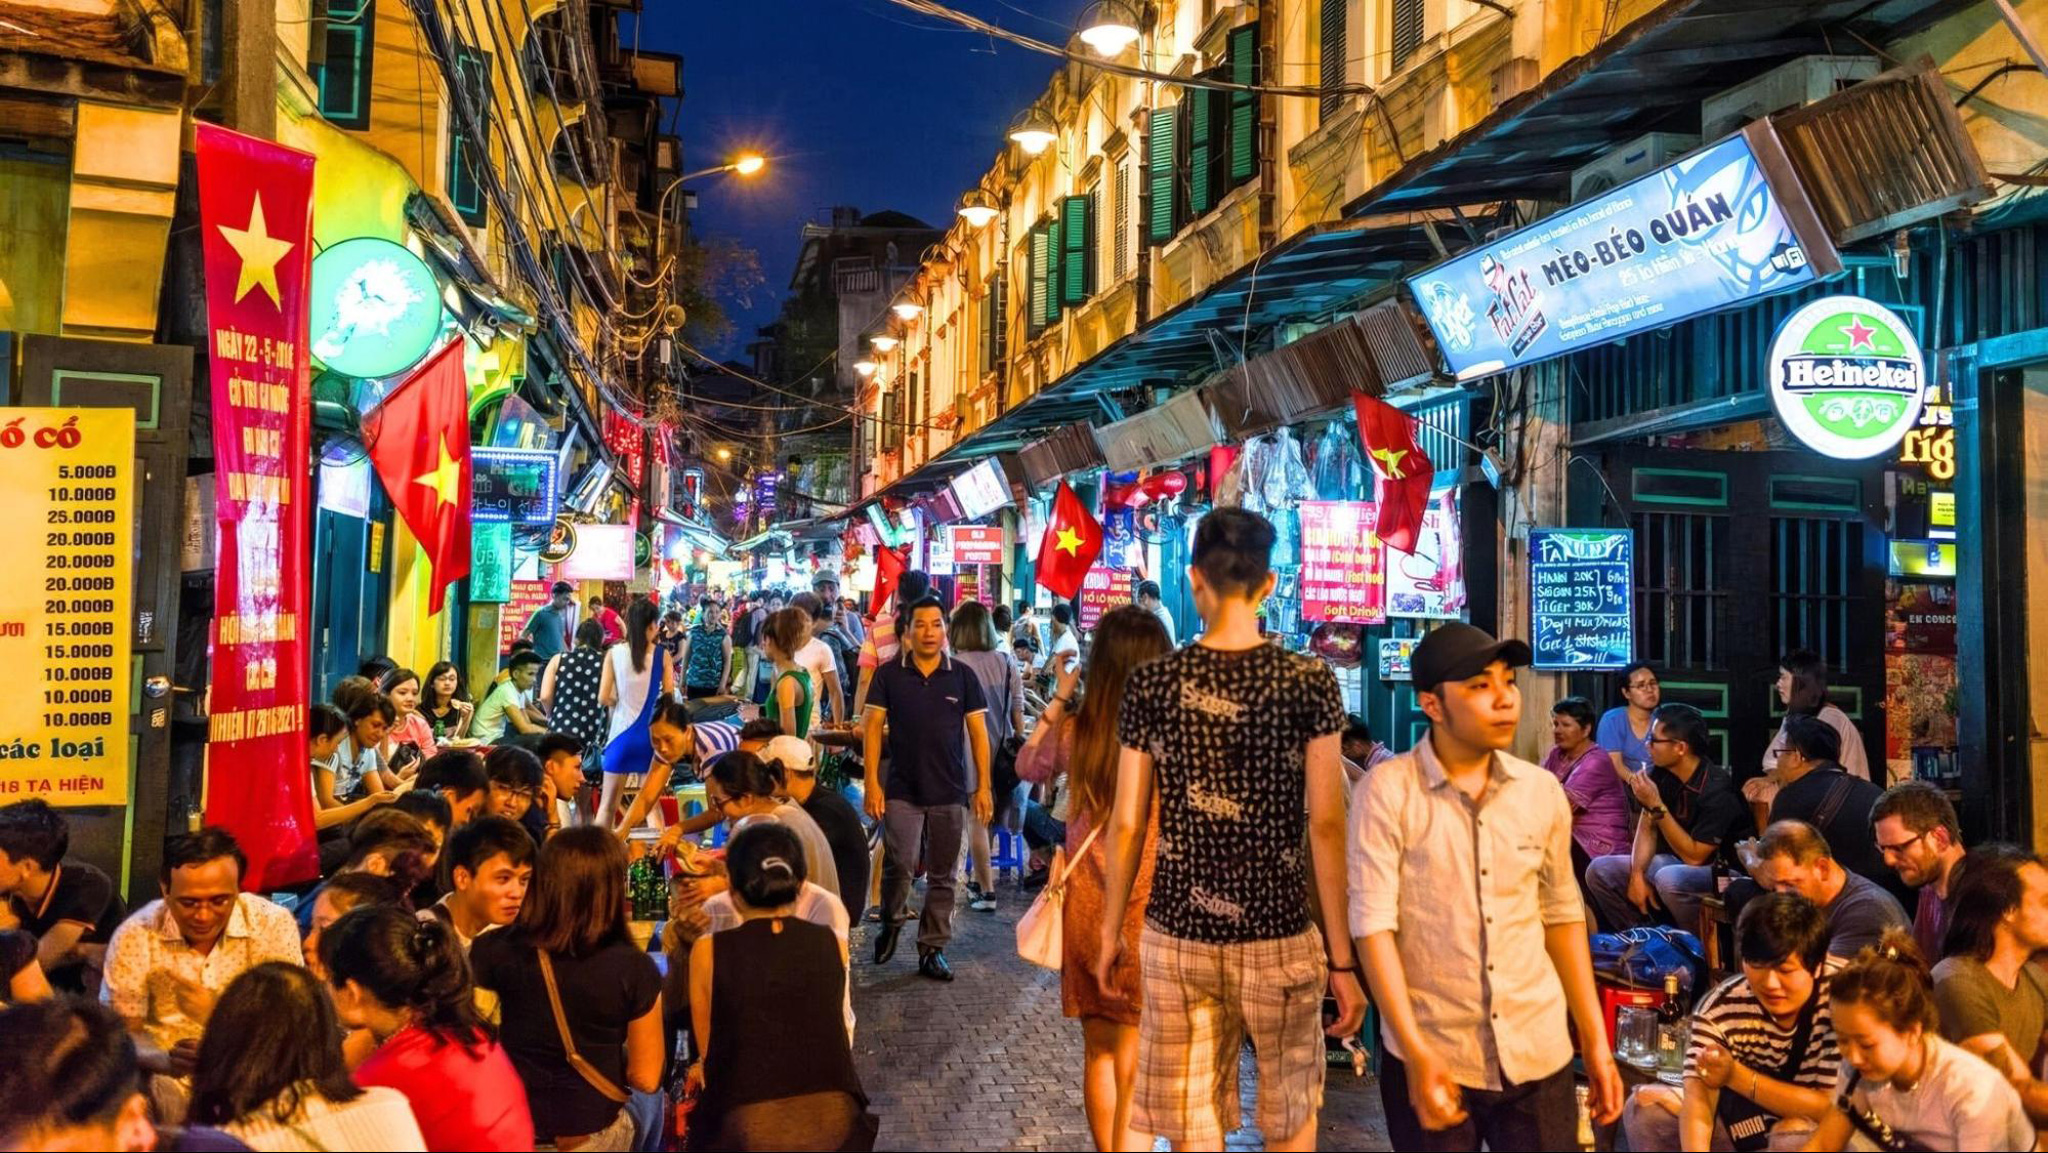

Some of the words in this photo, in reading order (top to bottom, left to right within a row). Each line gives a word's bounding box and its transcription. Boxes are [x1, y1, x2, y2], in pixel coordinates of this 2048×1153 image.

[1541, 226, 1645, 286] MÈO-BÉO
[1650, 192, 1733, 244] QUÁN
[216, 325, 242, 361] NGÀY
[50, 736, 105, 761] loại
[26, 779, 51, 795] TẠ
[59, 775, 104, 795] HIỆN
